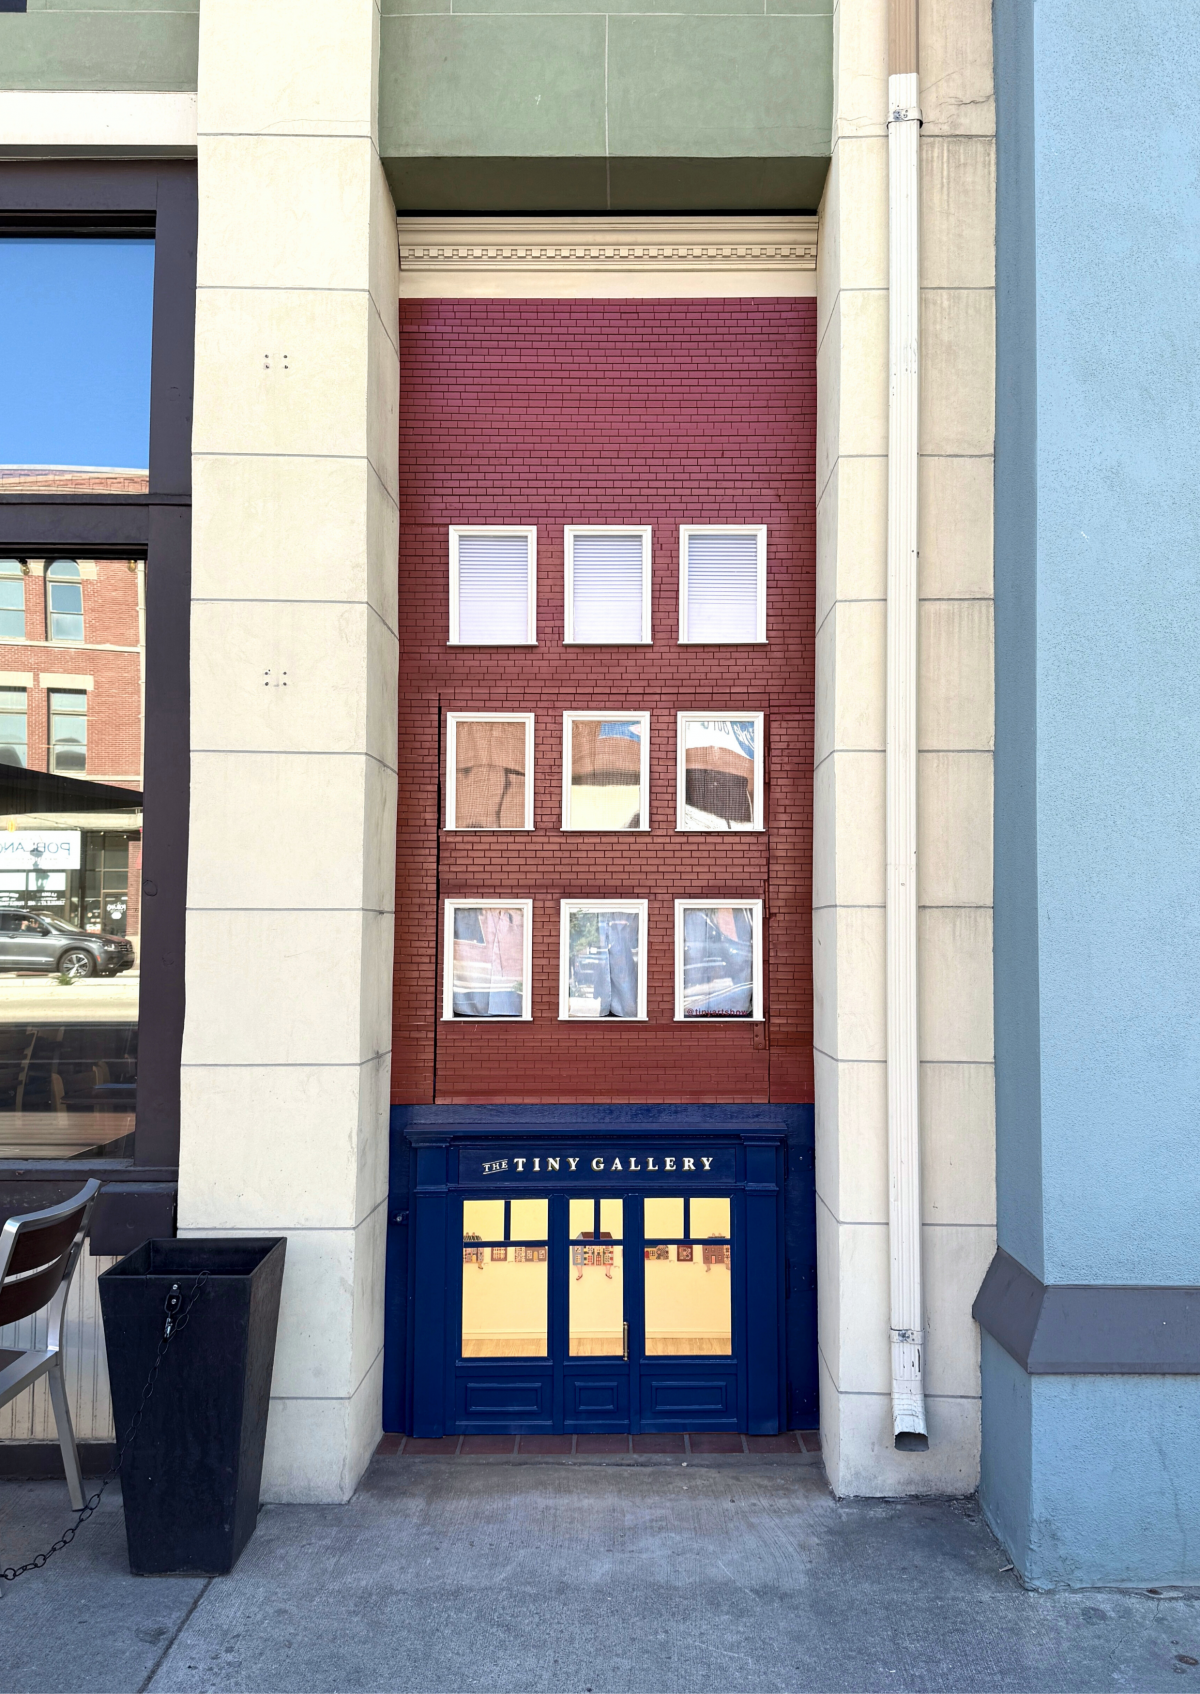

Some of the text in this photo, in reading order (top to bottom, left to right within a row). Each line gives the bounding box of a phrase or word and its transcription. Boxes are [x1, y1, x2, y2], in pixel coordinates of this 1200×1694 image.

[686, 1008, 748, 1018] @tinyartshow
[483, 1157, 714, 1172] THE TINY GALLERY
